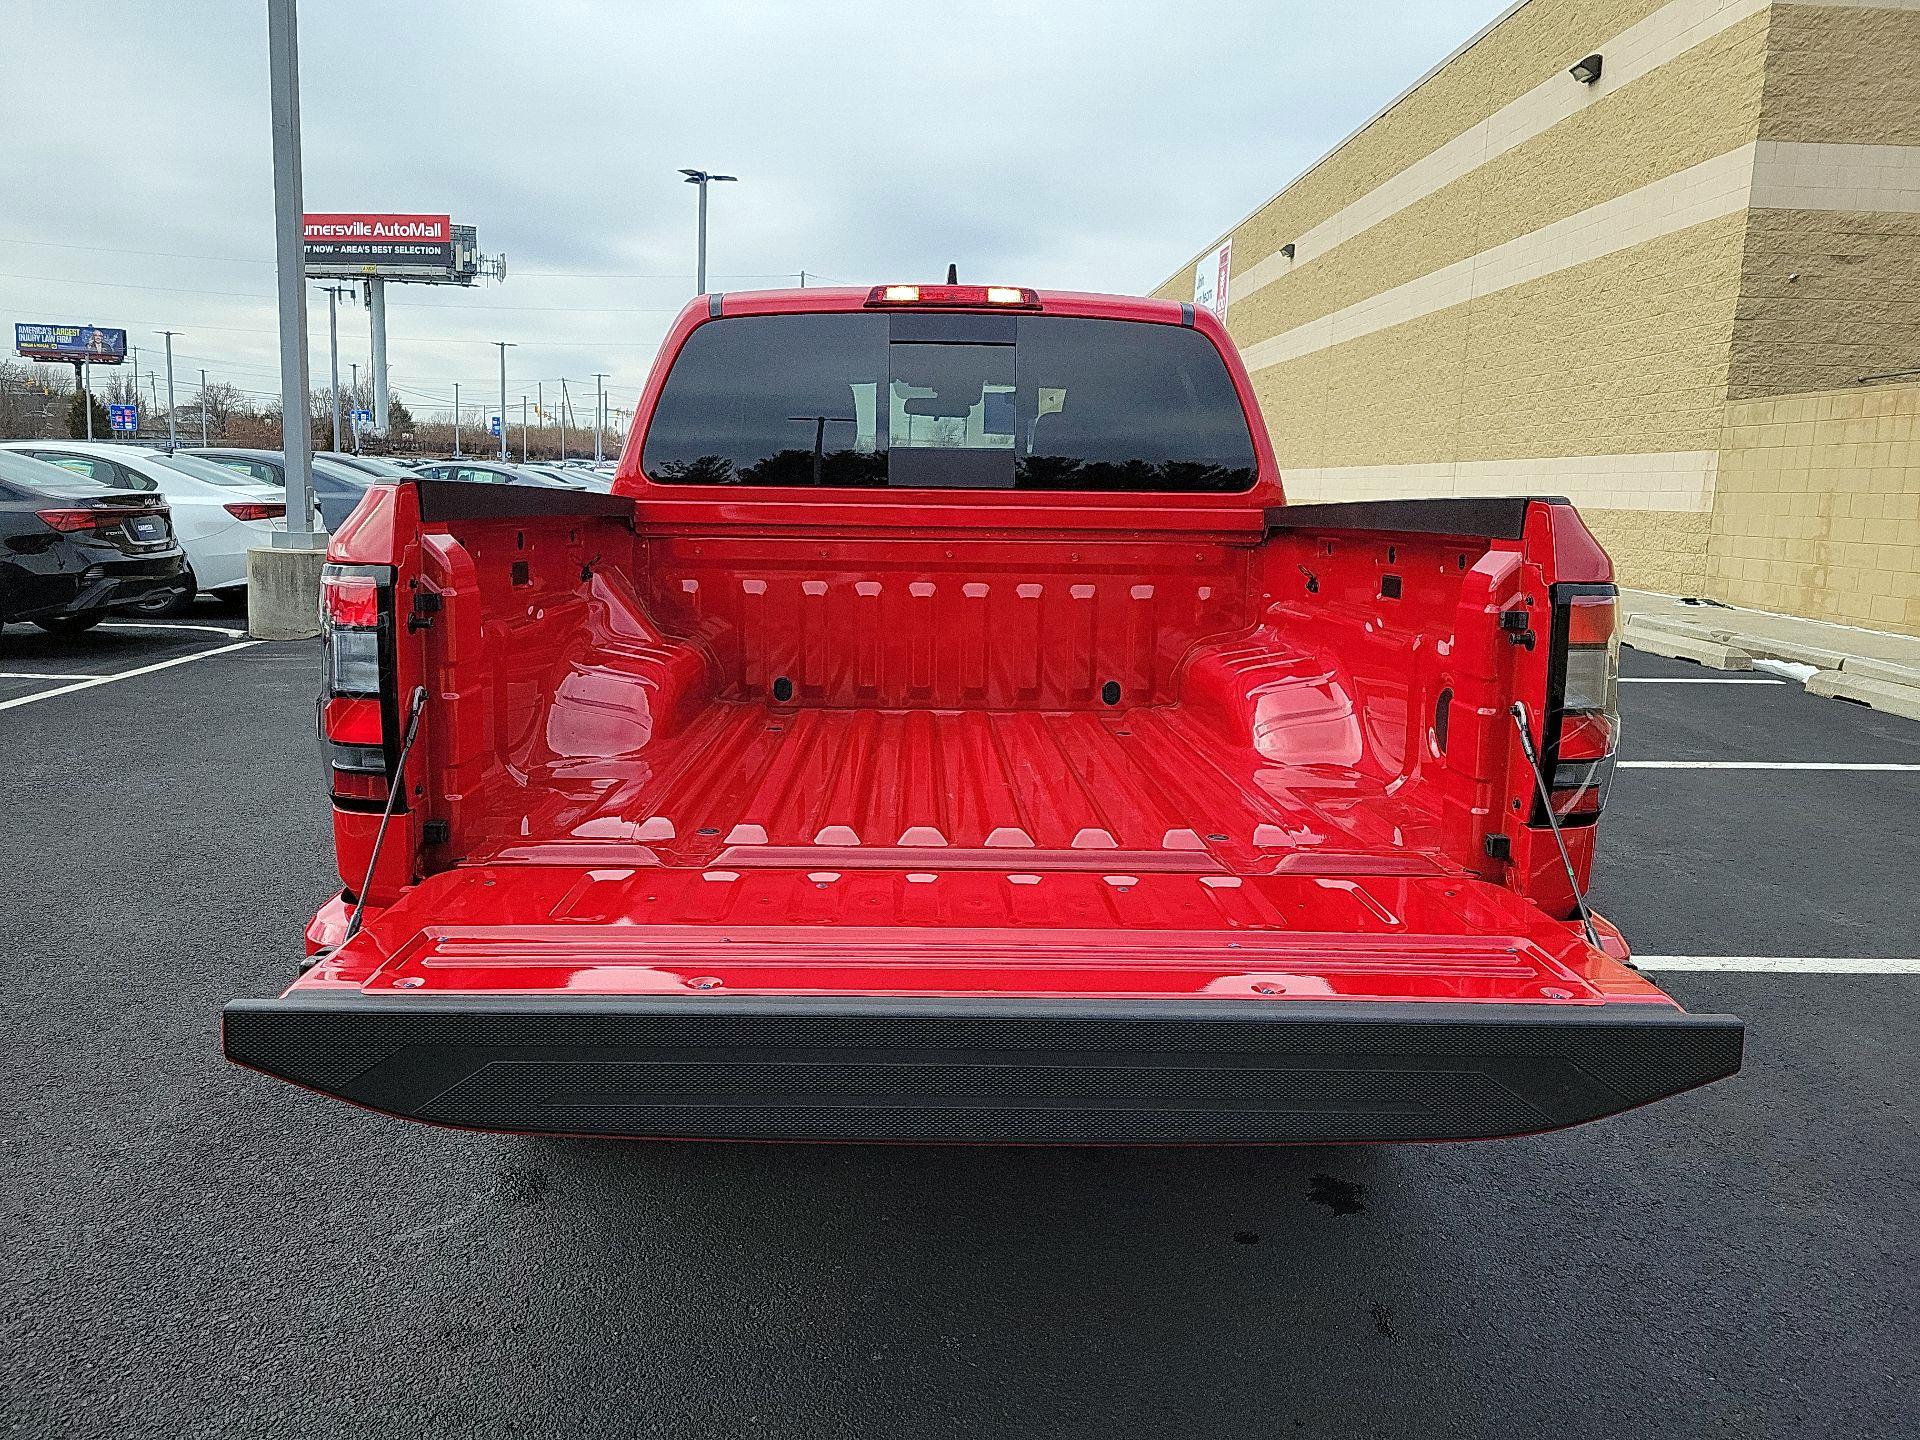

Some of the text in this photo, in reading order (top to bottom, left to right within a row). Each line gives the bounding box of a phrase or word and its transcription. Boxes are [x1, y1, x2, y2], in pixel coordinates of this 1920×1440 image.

[373, 222, 442, 237] AutoMall
[313, 245, 334, 253] NOW
[340, 245, 370, 254] AREA'S
[372, 245, 393, 254] BEST
[394, 246, 441, 255] SELECTION
[18, 325, 80, 337] AMERICA'S LARGEST
[18, 333, 72, 344] INJURY LAW FIRM
